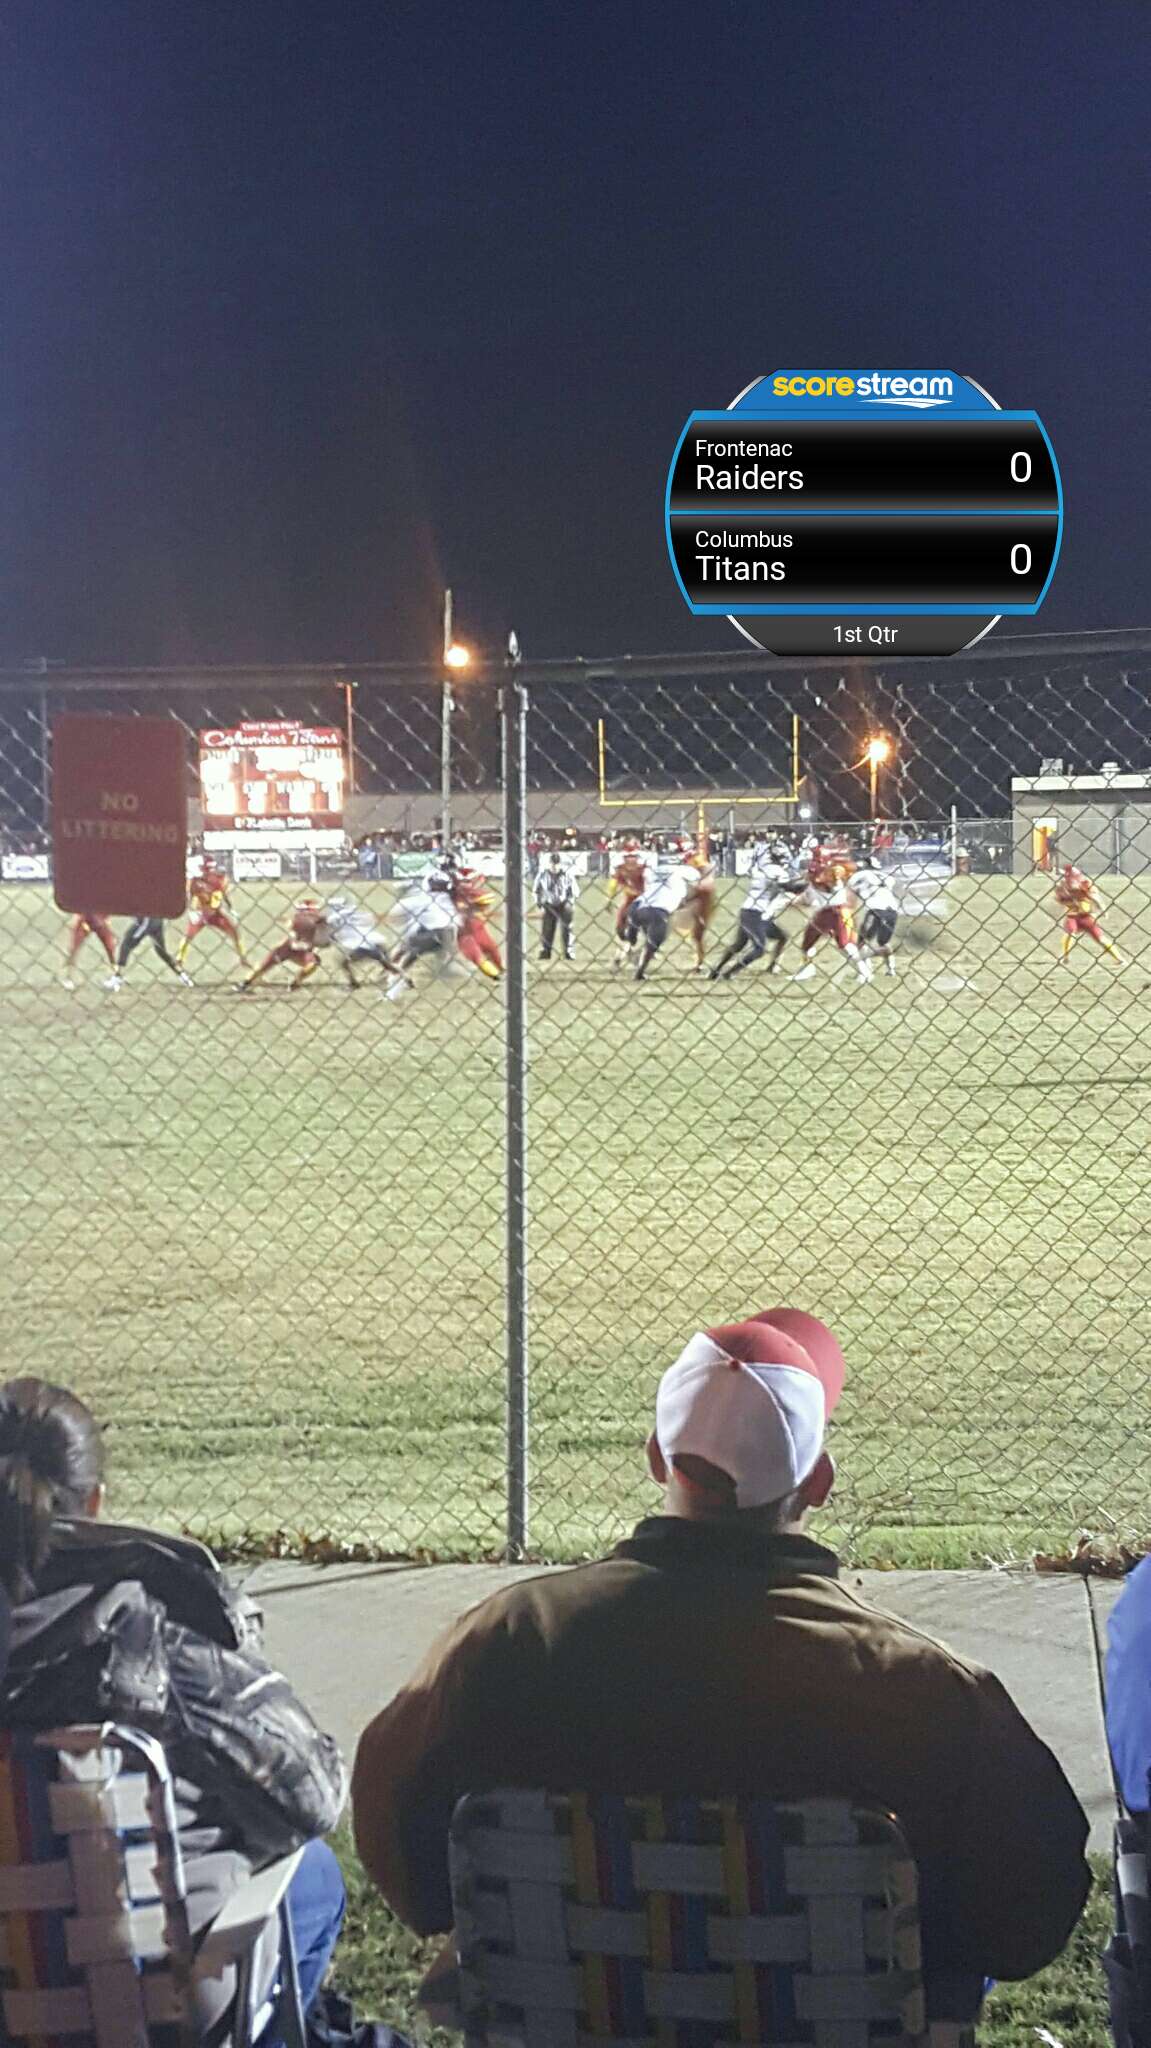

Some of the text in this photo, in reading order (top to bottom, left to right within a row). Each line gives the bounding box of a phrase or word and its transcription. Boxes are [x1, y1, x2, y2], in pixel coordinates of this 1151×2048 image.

[204, 729, 338, 747] Columbus Titans
[101, 791, 139, 811] NO
[61, 820, 178, 842] LITTERING
